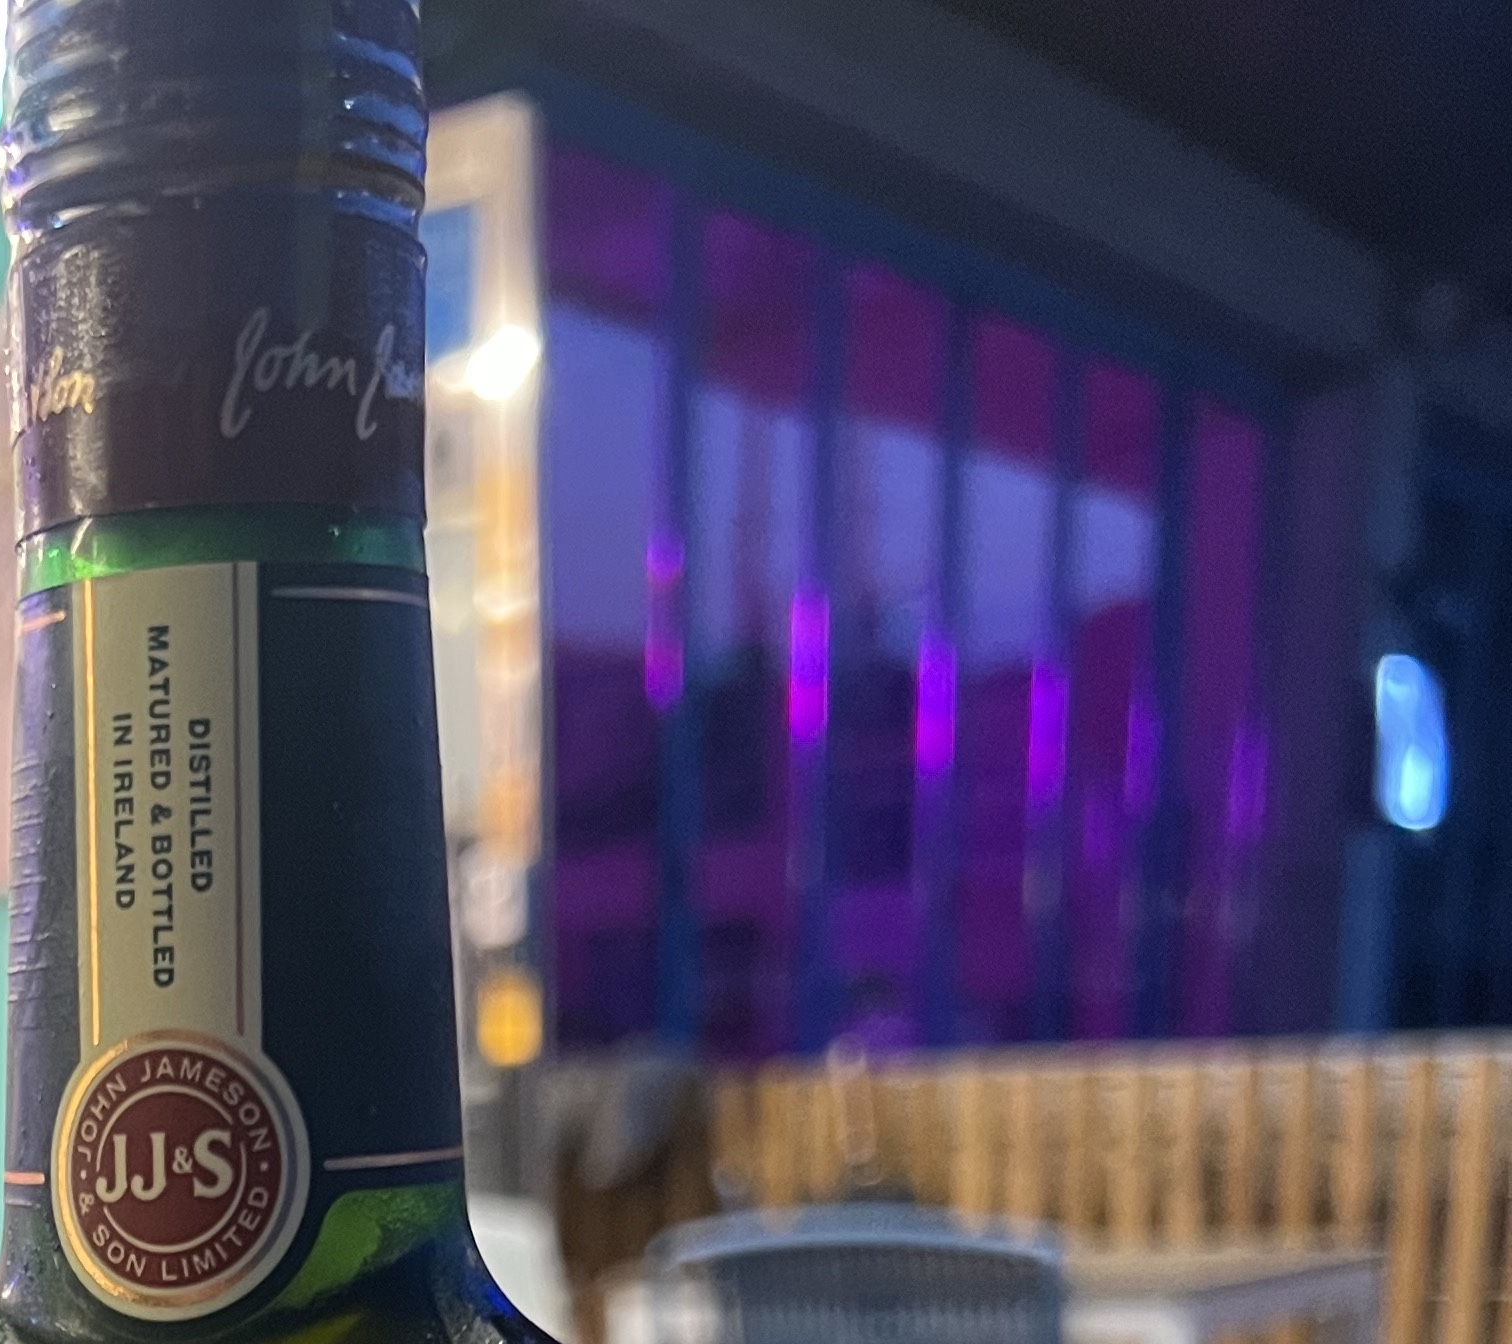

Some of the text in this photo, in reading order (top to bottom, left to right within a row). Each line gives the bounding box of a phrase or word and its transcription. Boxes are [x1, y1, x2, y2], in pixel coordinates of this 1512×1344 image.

[219, 307, 356, 438] John
[112, 713, 136, 910] IN IRELAND
[147, 625, 175, 989] MATURED & BOTTLED
[188, 717, 214, 893] DISTILLED
[77, 1055, 272, 1163] JOHN JAMESON
[95, 1129, 235, 1203] JJ&S
[92, 1224, 148, 1279] SON
[160, 1186, 270, 1281] LIMITED
